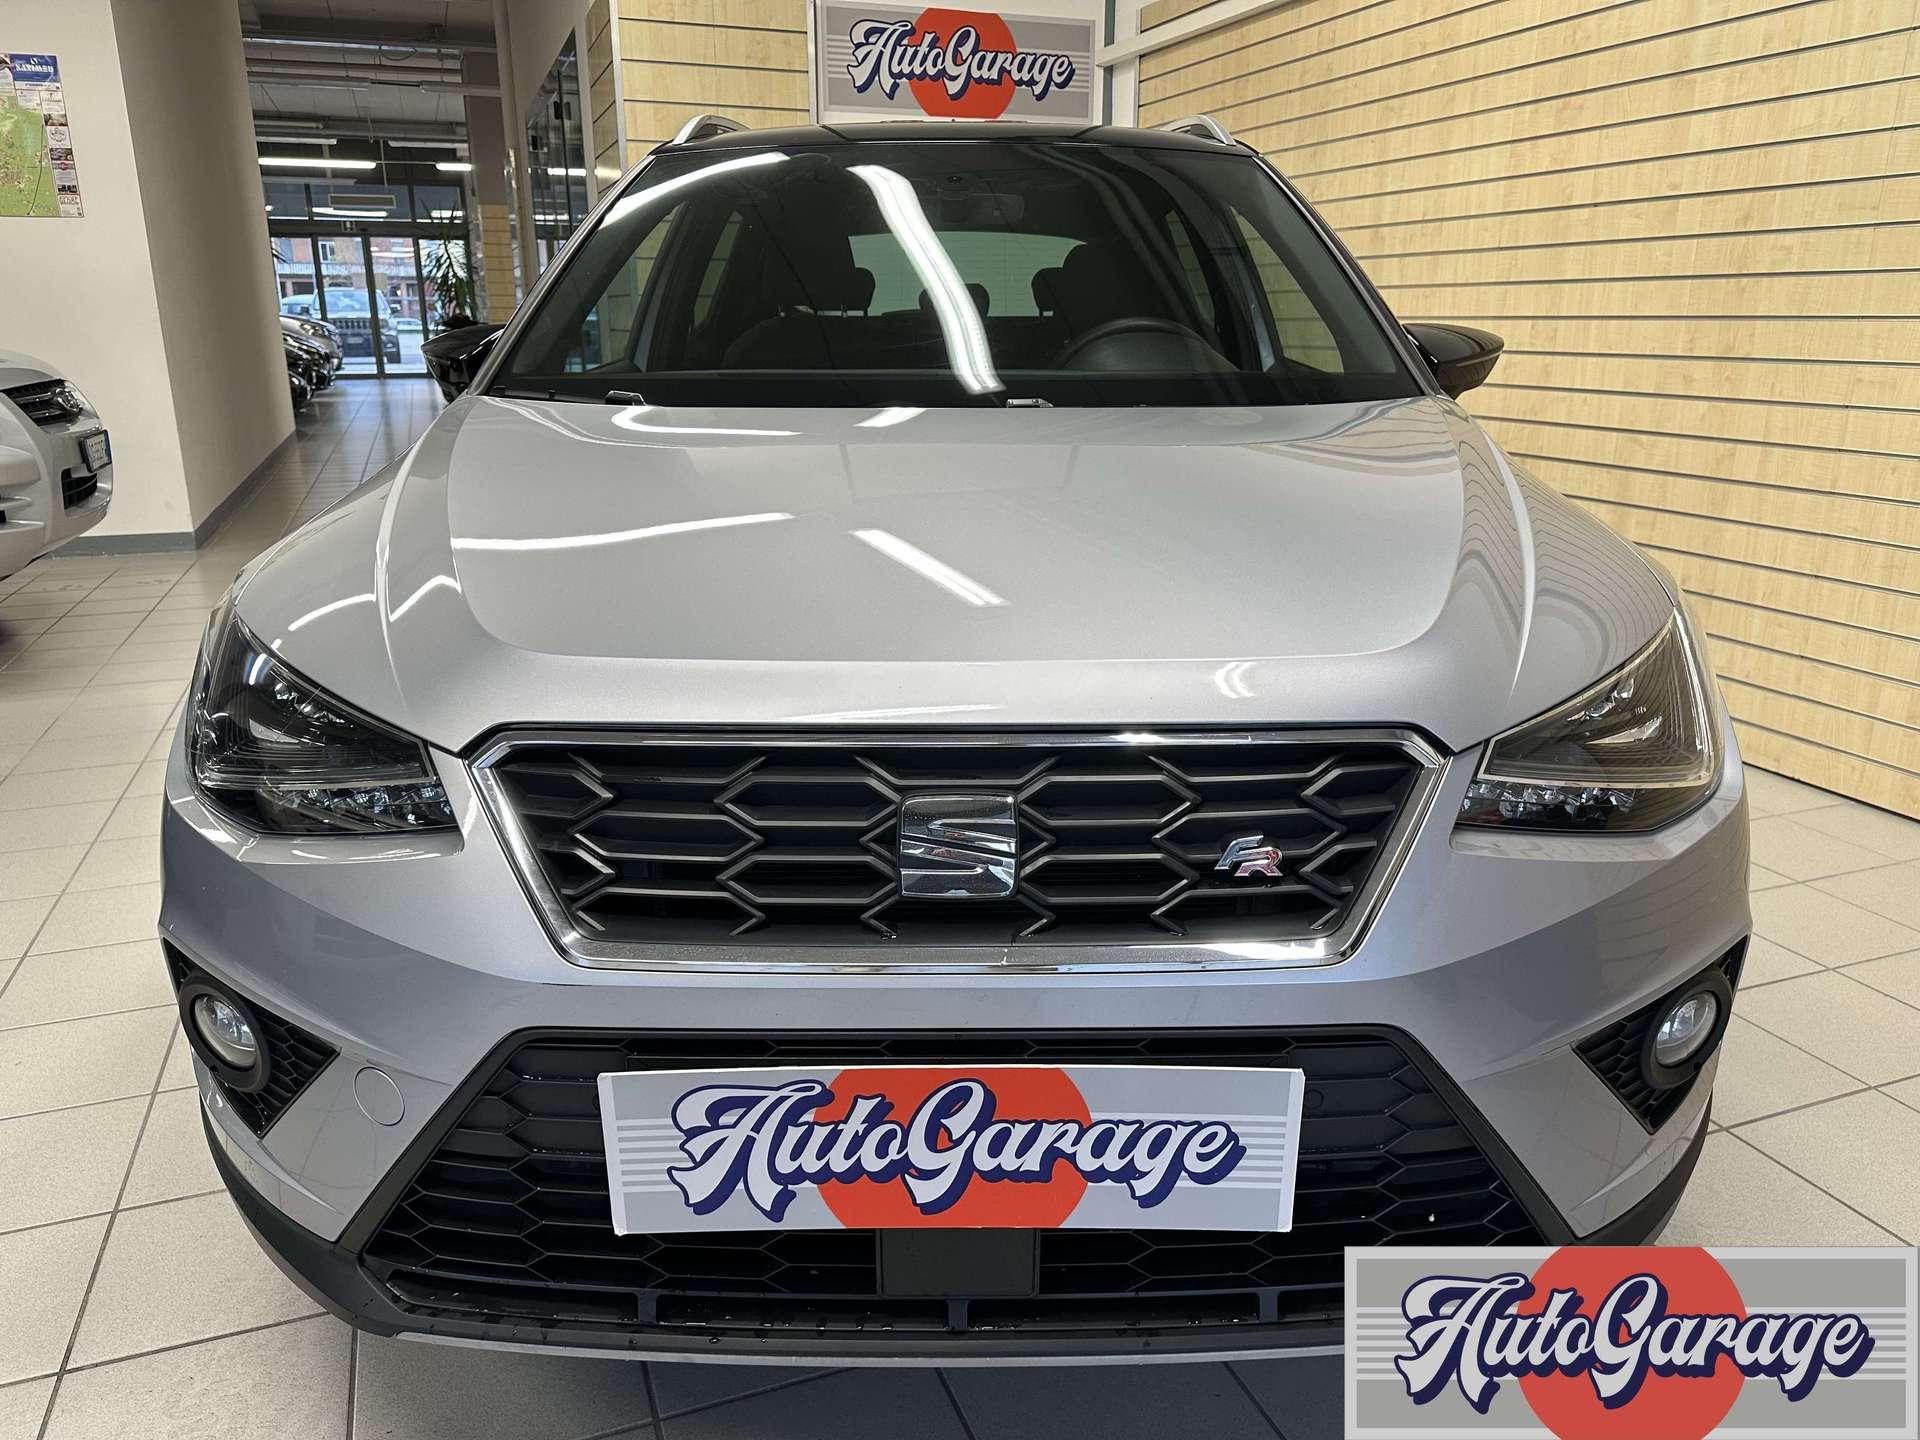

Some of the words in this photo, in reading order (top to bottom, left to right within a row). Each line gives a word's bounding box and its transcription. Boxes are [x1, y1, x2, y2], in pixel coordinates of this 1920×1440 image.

[847, 19, 1076, 101] AutoGarage
[1214, 834, 1283, 877] FR
[667, 1078, 1247, 1222] AutoGarage
